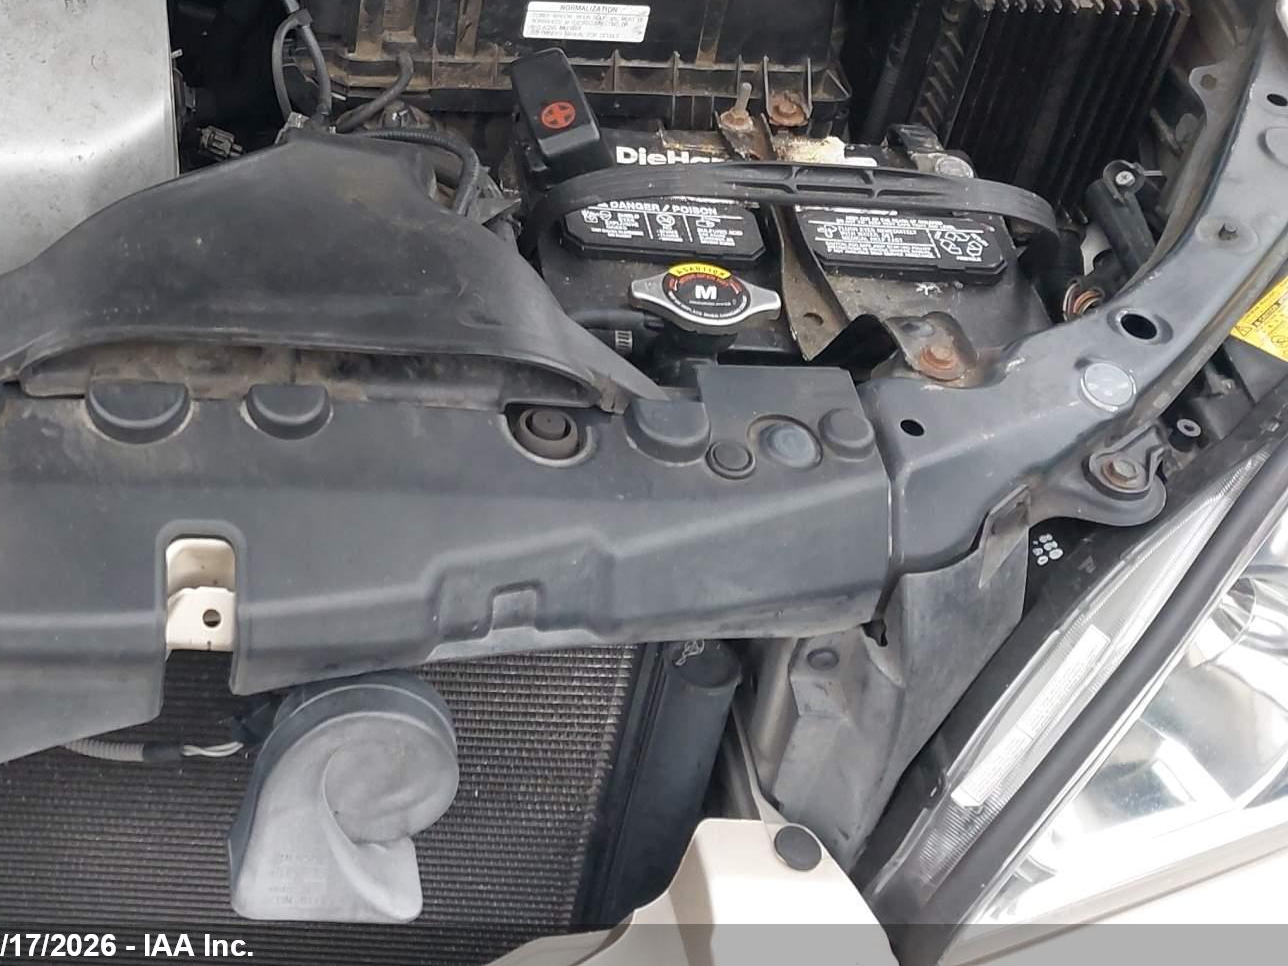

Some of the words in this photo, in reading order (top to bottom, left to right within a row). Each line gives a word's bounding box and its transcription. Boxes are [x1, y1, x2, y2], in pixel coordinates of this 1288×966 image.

[559, 4, 619, 13] NORMALIZATION
[610, 200, 660, 212] DANGER
[672, 204, 718, 216] POISON
[695, 284, 718, 300] M
